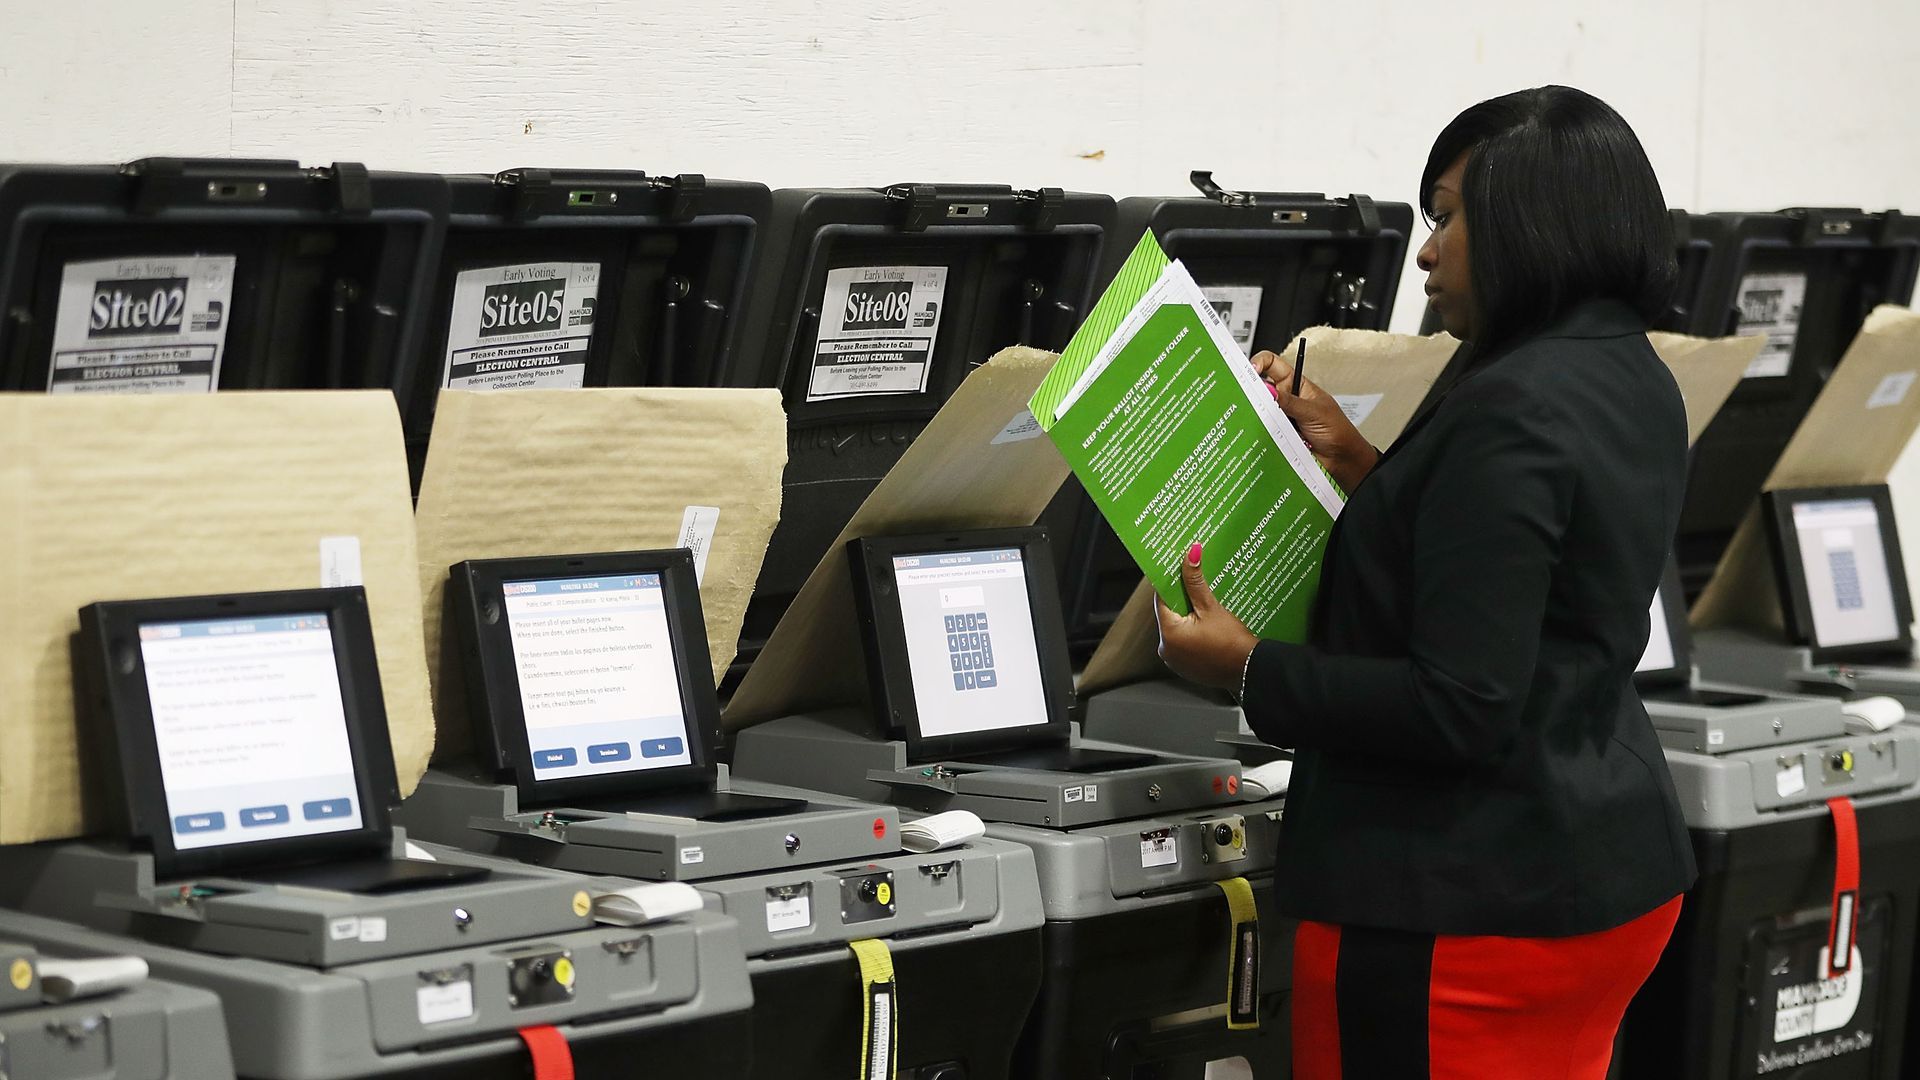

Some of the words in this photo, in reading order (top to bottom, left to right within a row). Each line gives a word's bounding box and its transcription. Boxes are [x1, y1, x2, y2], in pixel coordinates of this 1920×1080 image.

[504, 269, 526, 282] Early
[529, 267, 556, 280] Voting
[864, 270, 881, 282] Early
[883, 269, 906, 281] Voting
[92, 288, 185, 330] Site02
[481, 289, 564, 330] Site05
[844, 291, 910, 323] Site08
[470, 350, 496, 360] Please
[498, 344, 543, 358] Remember
[544, 344, 553, 352] to
[554, 342, 570, 350] Call
[833, 343, 853, 351] Please
[855, 342, 890, 350] Remember
[898, 341, 913, 349] Call
[476, 360, 519, 373] ELECTION
[520, 355, 560, 367] CENTRAL
[837, 353, 871, 363] ELECTION
[870, 353, 904, 361] CENTRAL
[83, 365, 133, 379] ELECTION
[135, 362, 181, 376] CENTRAL
[468, 376, 483, 386] Before
[485, 375, 504, 384] Leaving
[517, 371, 534, 379] Polling
[535, 369, 550, 377] Place
[848, 373, 868, 381] Collection
[492, 381, 518, 390] Collection
[518, 379, 536, 387] Center
[1081, 430, 1096, 449] KEEP
[1096, 412, 1114, 432] YOUR
[1112, 387, 1134, 414] BALLOT
[1133, 366, 1154, 390] INSIDE
[1152, 351, 1166, 368] THIS
[1165, 326, 1189, 353] FOLDER
[1123, 404, 1131, 416] AT
[1131, 393, 1142, 407] ALL
[1140, 373, 1158, 394] TIMES
[1134, 488, 1165, 527] MANTENGA
[1164, 477, 1173, 490] SU
[1172, 454, 1193, 480] BOLETA
[1192, 427, 1216, 456] DENTRO
[1215, 417, 1225, 429] DE
[1223, 403, 1237, 420] ESTA
[1153, 492, 1173, 516] FUNDA
[1172, 481, 1181, 493] EN
[1180, 461, 1198, 483] TODO
[1197, 427, 1226, 463] MOMENTO
[1208, 571, 1224, 592] ILTEN
[1233, 549, 1241, 559] W
[1240, 538, 1250, 552] AN
[1249, 507, 1275, 541] ANDEDAN
[1273, 487, 1291, 510] KATAB
[1242, 533, 1266, 561] TOUTAN
[948, 620, 953, 628] 1
[958, 619, 963, 627] 2
[969, 618, 974, 626] 3
[951, 639, 956, 648] 4
[961, 638, 966, 647] 5
[972, 637, 977, 646] 6
[954, 658, 958, 666] 7
[965, 657, 969, 666] 8
[975, 656, 980, 665] 9
[967, 675, 972, 685] 0
